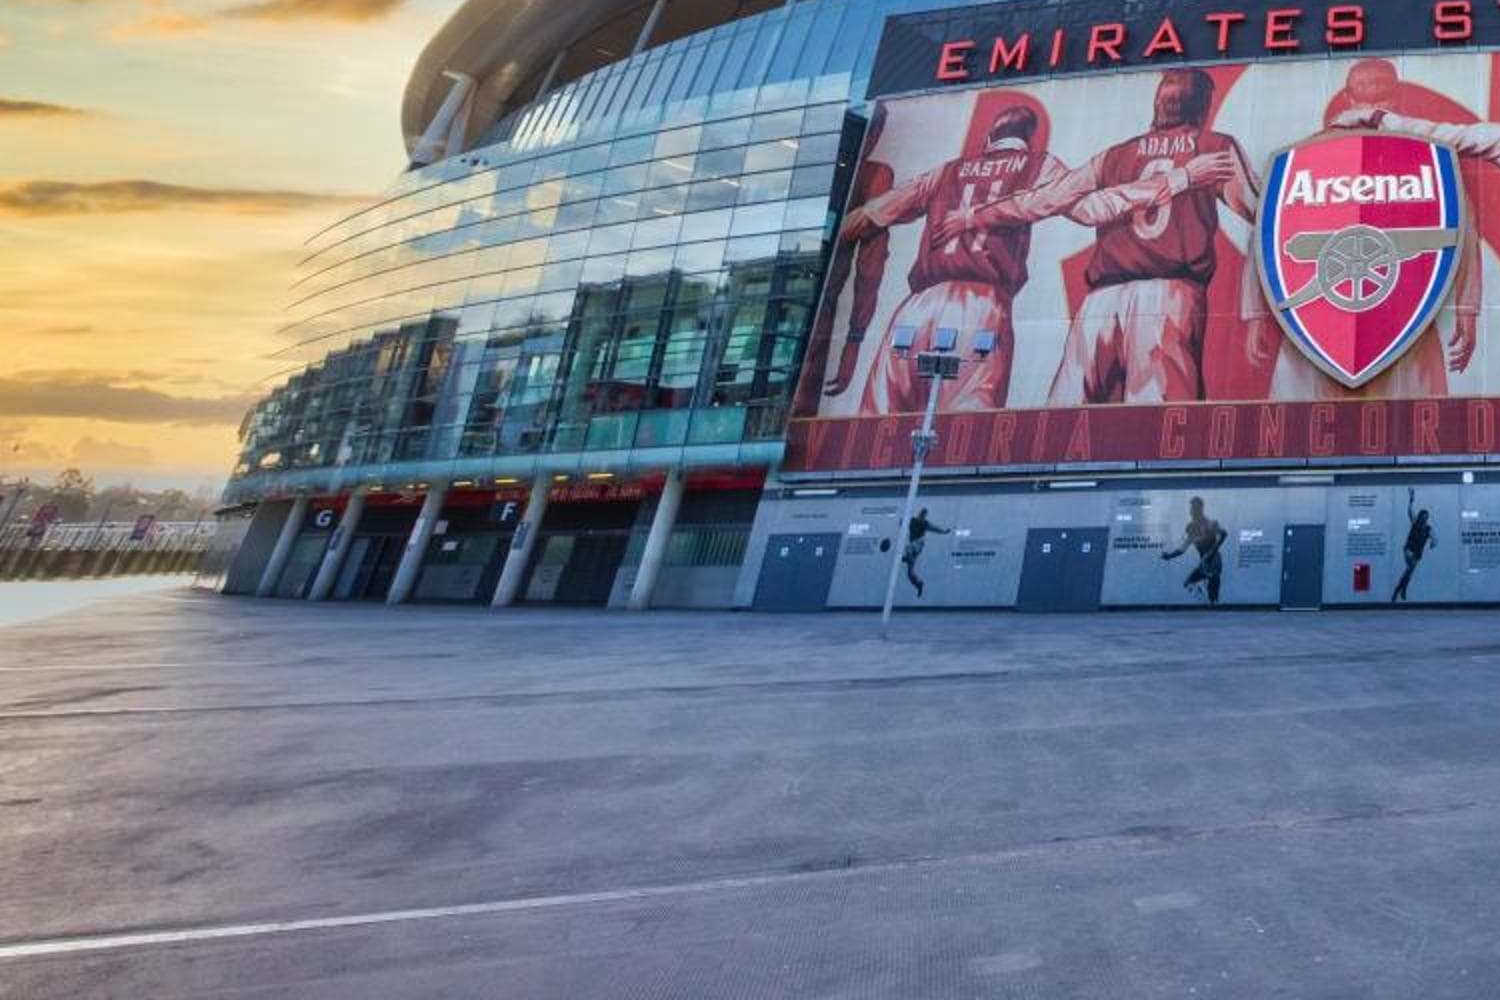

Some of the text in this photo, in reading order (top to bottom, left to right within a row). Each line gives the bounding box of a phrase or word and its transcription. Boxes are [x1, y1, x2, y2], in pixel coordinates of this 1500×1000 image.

[936, 5, 1364, 80] EMIRATES
[1137, 135, 1196, 156] ADAMS
[959, 155, 1029, 177] BASTIN
[1285, 165, 1433, 207] Arsenal
[805, 409, 1091, 471] VICORIA
[315, 509, 333, 527] G
[500, 502, 516, 520] F
